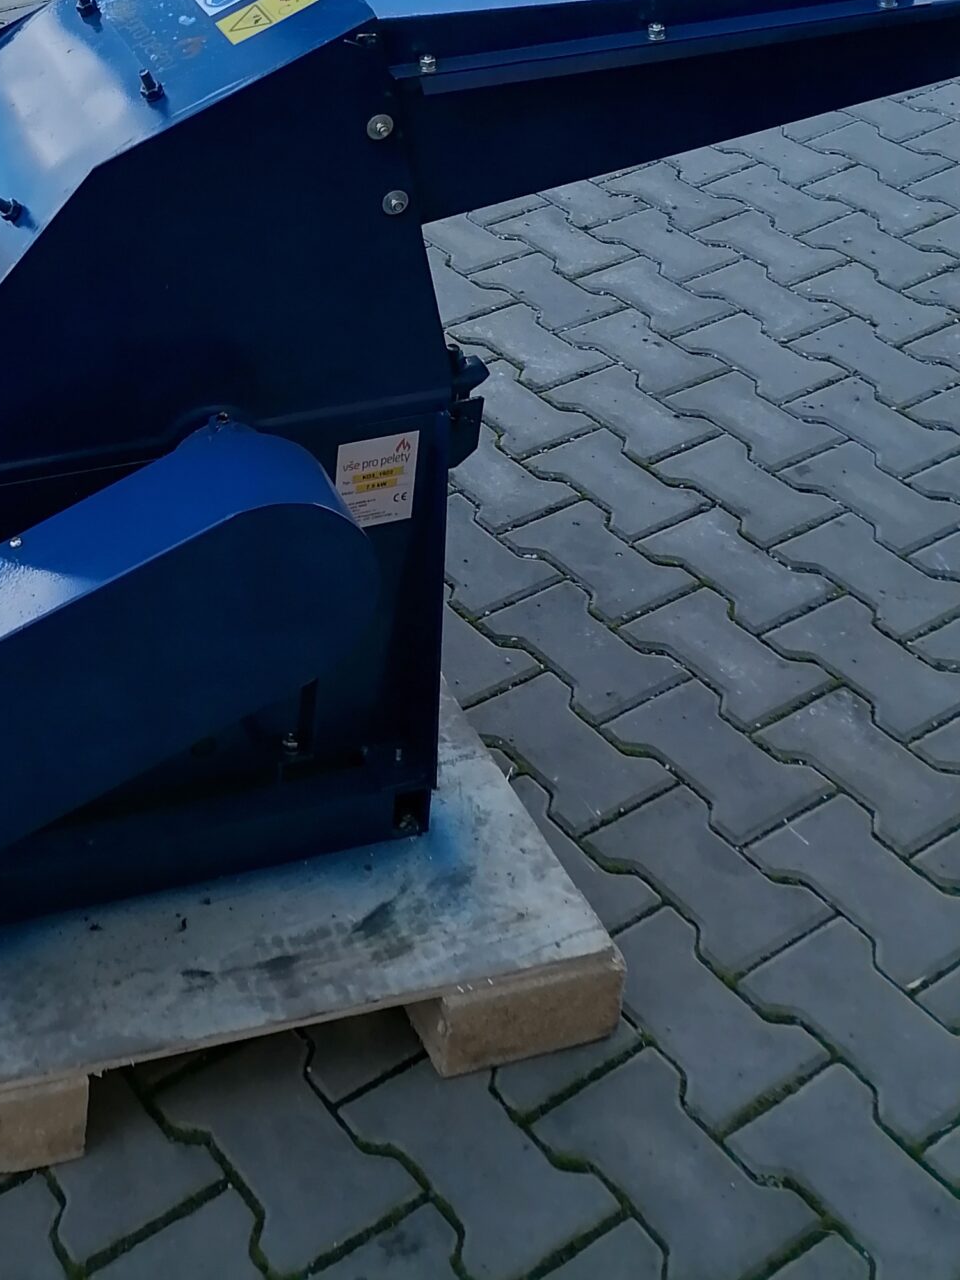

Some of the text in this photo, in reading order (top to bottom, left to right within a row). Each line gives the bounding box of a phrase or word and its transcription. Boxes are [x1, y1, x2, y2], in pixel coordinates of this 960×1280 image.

[343, 453, 410, 472] vše pro pelety
[393, 491, 408, 503] CE
